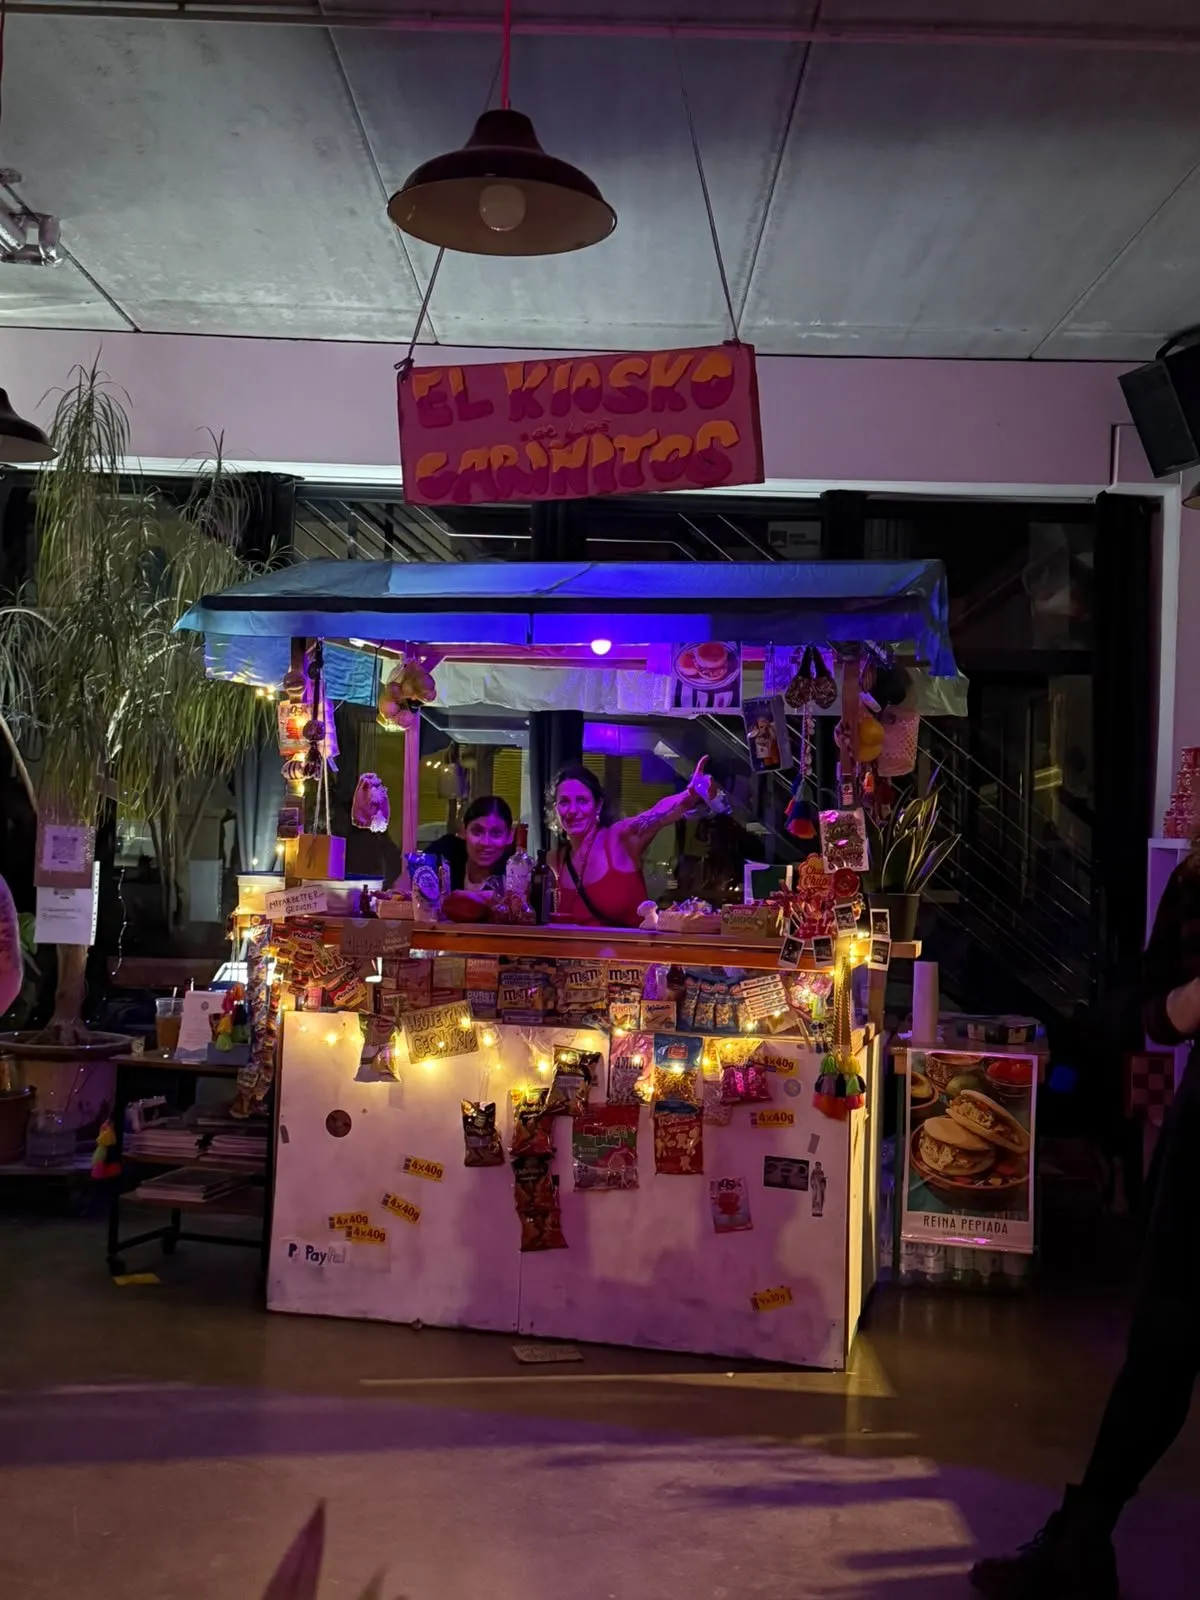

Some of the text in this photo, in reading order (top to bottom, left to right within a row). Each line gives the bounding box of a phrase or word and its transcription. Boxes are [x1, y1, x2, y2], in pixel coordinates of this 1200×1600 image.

[413, 351, 735, 428] EL KIOSKO
[923, 1214, 956, 1229] REINA
[961, 1218, 1008, 1234] PEPIADA
